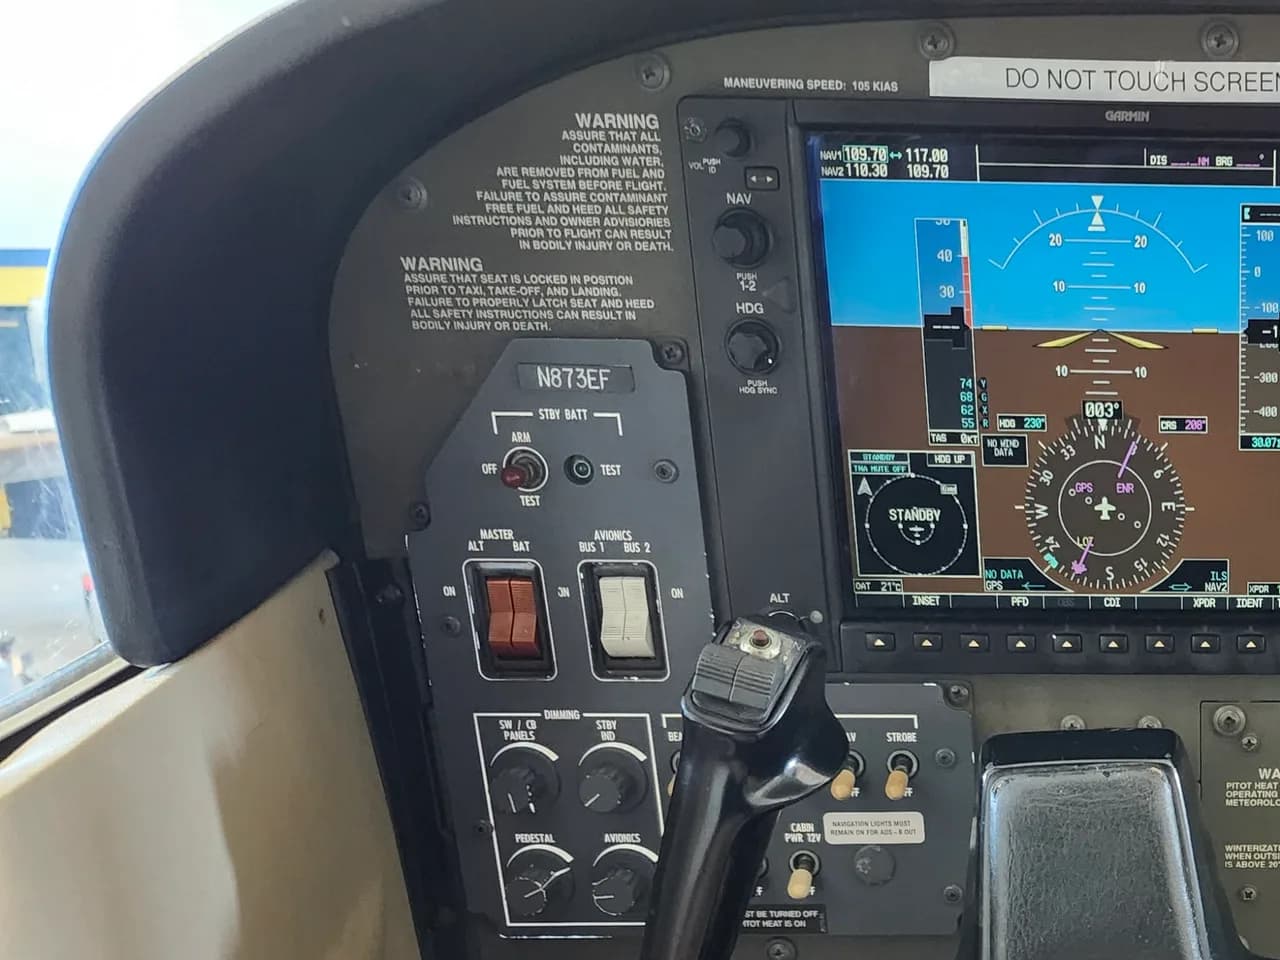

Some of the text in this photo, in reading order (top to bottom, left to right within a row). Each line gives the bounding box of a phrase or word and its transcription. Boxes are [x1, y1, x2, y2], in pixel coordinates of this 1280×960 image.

[723, 76, 898, 91] MANEUVERING SPEED: 105 KIAS
[1006, 67, 1039, 88] DO
[1048, 68, 1097, 91] NOT
[1104, 69, 1185, 92] TOUCH
[574, 112, 658, 129] WARNING
[1106, 110, 1149, 122] GARMIN
[561, 130, 660, 141] ASSURE THAT ALL
[572, 142, 662, 155] CONTAMINANTS,
[559, 154, 664, 167] INCLUDING WATER,
[820, 148, 948, 162] NAV1 109.70 117.00
[821, 164, 949, 178] NAV2 110.30 109.70
[726, 192, 752, 205] NAV
[400, 255, 482, 272] WARNING
[404, 273, 633, 286] ASSURE THAT SEAT IS LOCKED IN POSITION
[735, 302, 764, 314] HDG
[536, 365, 611, 390] N873EF
[538, 409, 588, 420] STBY BATT
[1084, 402, 1120, 417] 003°
[511, 432, 531, 443] ARM
[481, 464, 497, 475] OFF
[600, 465, 621, 476] TEST
[519, 495, 541, 507] TEST
[888, 508, 941, 522] STANDBY
[480, 529, 514, 540] MASTER
[594, 530, 632, 541] AVIONICS
[468, 541, 484, 552] ALT
[513, 541, 530, 552] BAT
[579, 542, 605, 553] BUS 1
[624, 542, 651, 553] BUS 2
[985, 569, 1023, 580] NO DATA
[443, 586, 456, 597] ON
[985, 581, 1003, 591] GPS
[671, 588, 684, 599] ON
[769, 592, 790, 603] ALT
[912, 596, 940, 606] INSET
[1011, 597, 1029, 608] PFD
[1103, 598, 1121, 608] CDI
[1193, 598, 1216, 608] XPDR
[1236, 598, 1264, 609] IDENT
[544, 710, 580, 720] DIMMING
[503, 731, 535, 741] PANELS
[886, 732, 917, 743] STROBE
[1226, 782, 1252, 790] PITOT
[1254, 782, 1279, 790] HEAT
[790, 823, 814, 833] CABIN
[515, 833, 556, 843] PEDESTAL
[604, 833, 641, 843] AVIONICS
[784, 833, 821, 843] PWR 12V
